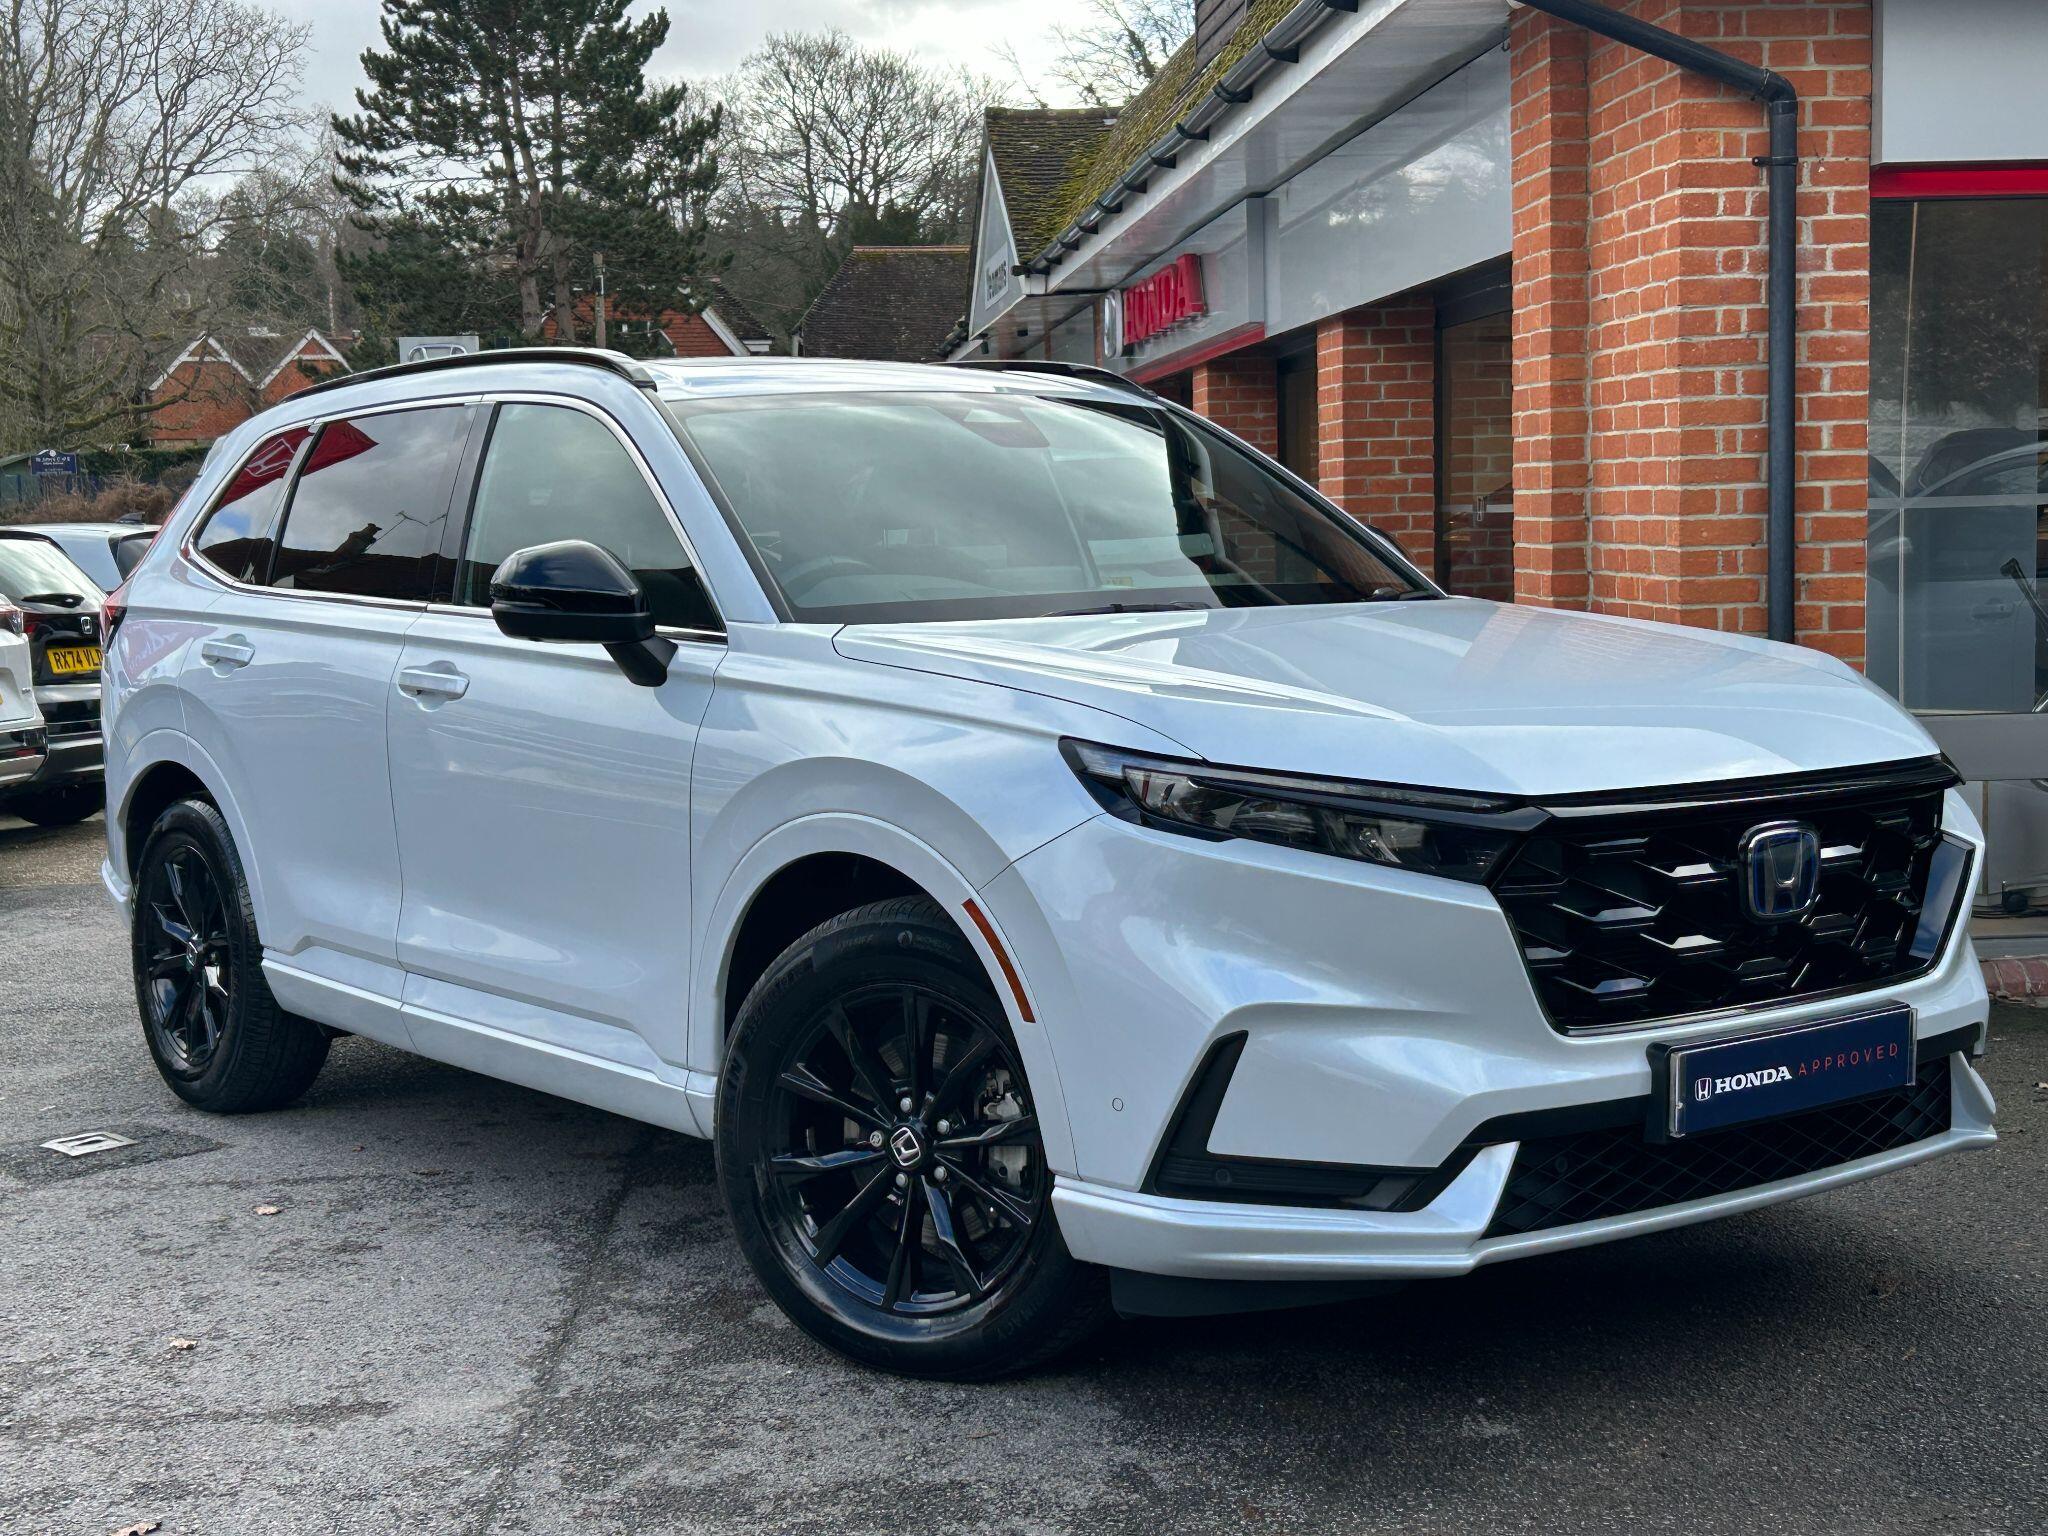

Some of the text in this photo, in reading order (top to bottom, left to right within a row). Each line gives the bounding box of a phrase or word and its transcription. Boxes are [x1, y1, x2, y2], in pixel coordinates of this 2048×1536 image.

[1123, 253, 1204, 346] HONDA
[53, 650, 84, 669] RX74
[1714, 1065, 1793, 1094] HONDA
[1798, 1042, 1898, 1076] APPROVED
